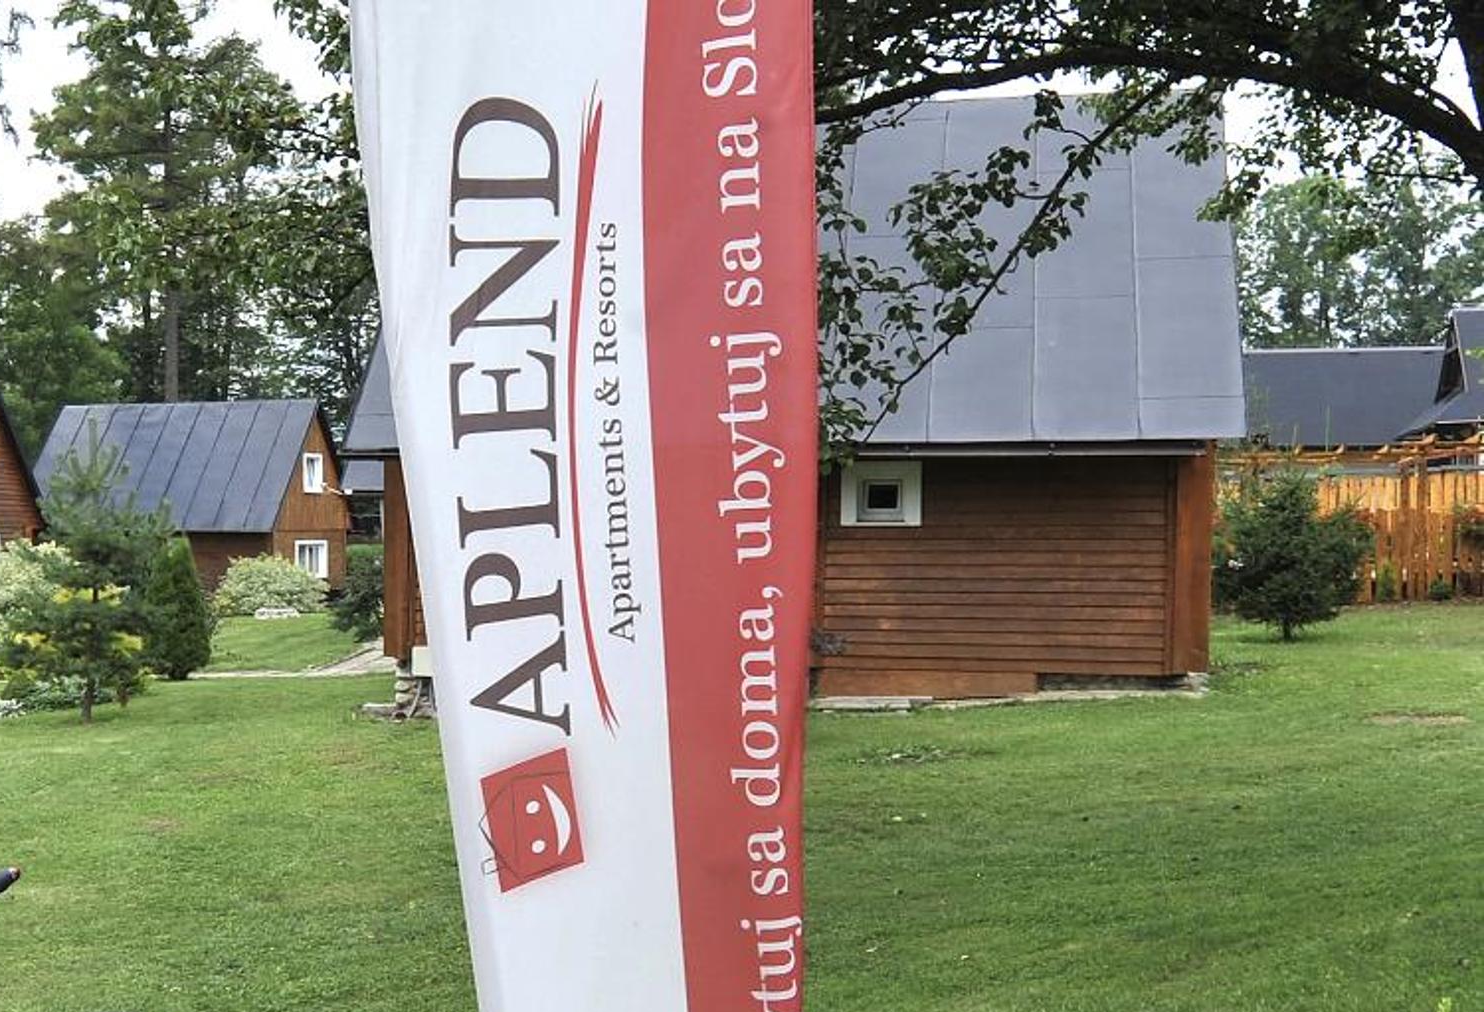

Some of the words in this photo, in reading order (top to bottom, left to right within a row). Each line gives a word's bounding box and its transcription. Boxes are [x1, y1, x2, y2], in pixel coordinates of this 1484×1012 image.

[701, 0, 758, 98] Slo
[717, 117, 761, 214] na
[593, 222, 618, 366] Resorts
[722, 231, 763, 308] sa
[449, 96, 571, 736] APLEND
[594, 376, 621, 407] &
[709, 331, 786, 565] ubytuj
[598, 418, 642, 643] Apartments
[730, 585, 783, 807] doma,
[747, 825, 789, 896] sa
